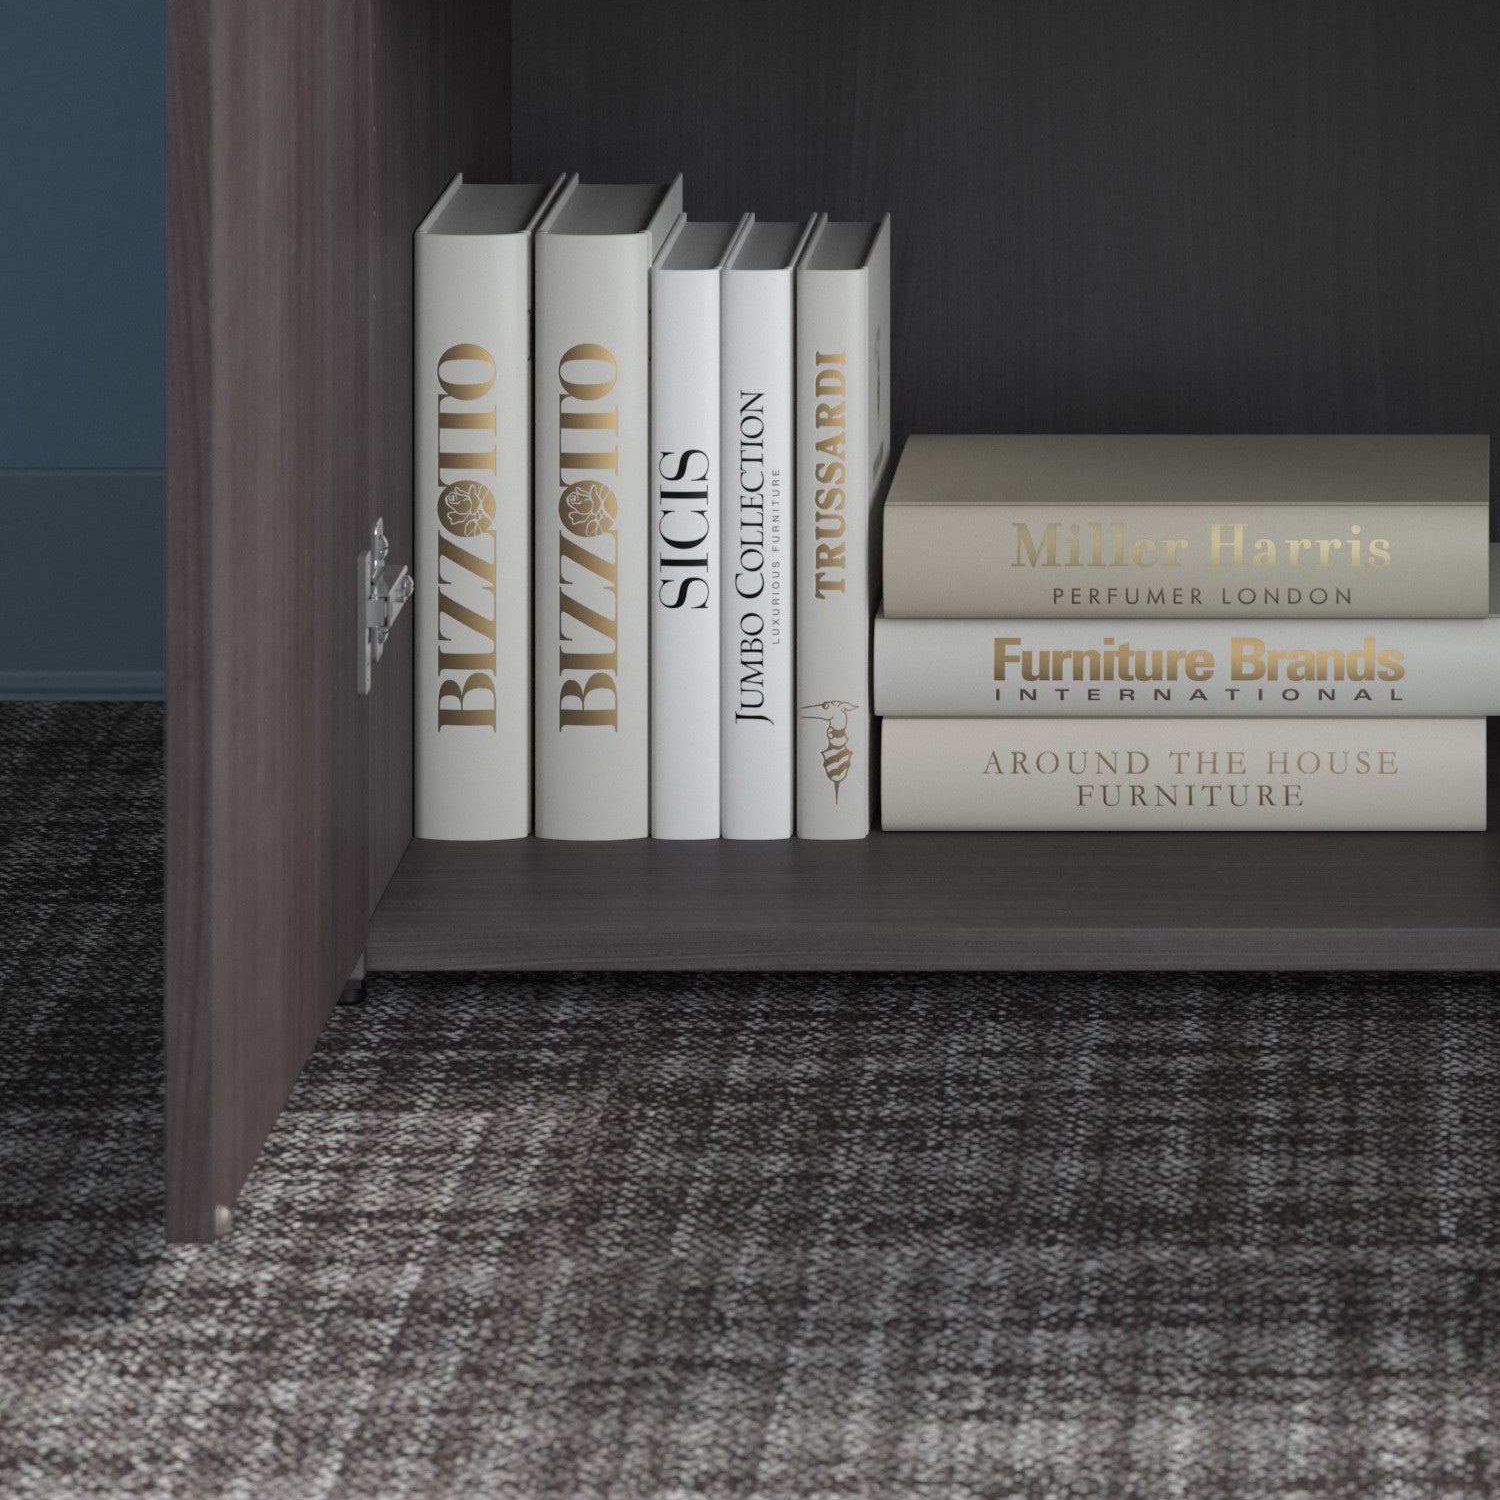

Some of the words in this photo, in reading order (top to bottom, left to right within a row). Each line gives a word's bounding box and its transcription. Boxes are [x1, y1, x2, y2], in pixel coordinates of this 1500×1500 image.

[734, 389, 766, 599] COLLECTION
[814, 350, 848, 601] TRUSSARDI
[658, 448, 710, 610] SICIS
[771, 468, 781, 553] FURNITURE
[1010, 521, 1189, 569] Miller
[1205, 521, 1393, 569] Harris
[771, 560, 781, 645] LUXURIOUS
[1052, 587, 1204, 606] PERFUMER
[1221, 587, 1353, 606] LONDON
[734, 612, 775, 726] JUMBO
[992, 636, 1216, 683] Furniture
[1229, 636, 1407, 683] Brands
[994, 688, 1405, 702] INTERNATIONAL
[981, 750, 1151, 776] AROUND
[1168, 750, 1247, 776] THE
[1266, 750, 1400, 776] HOUSE
[1076, 784, 1304, 807] FURNITURE
